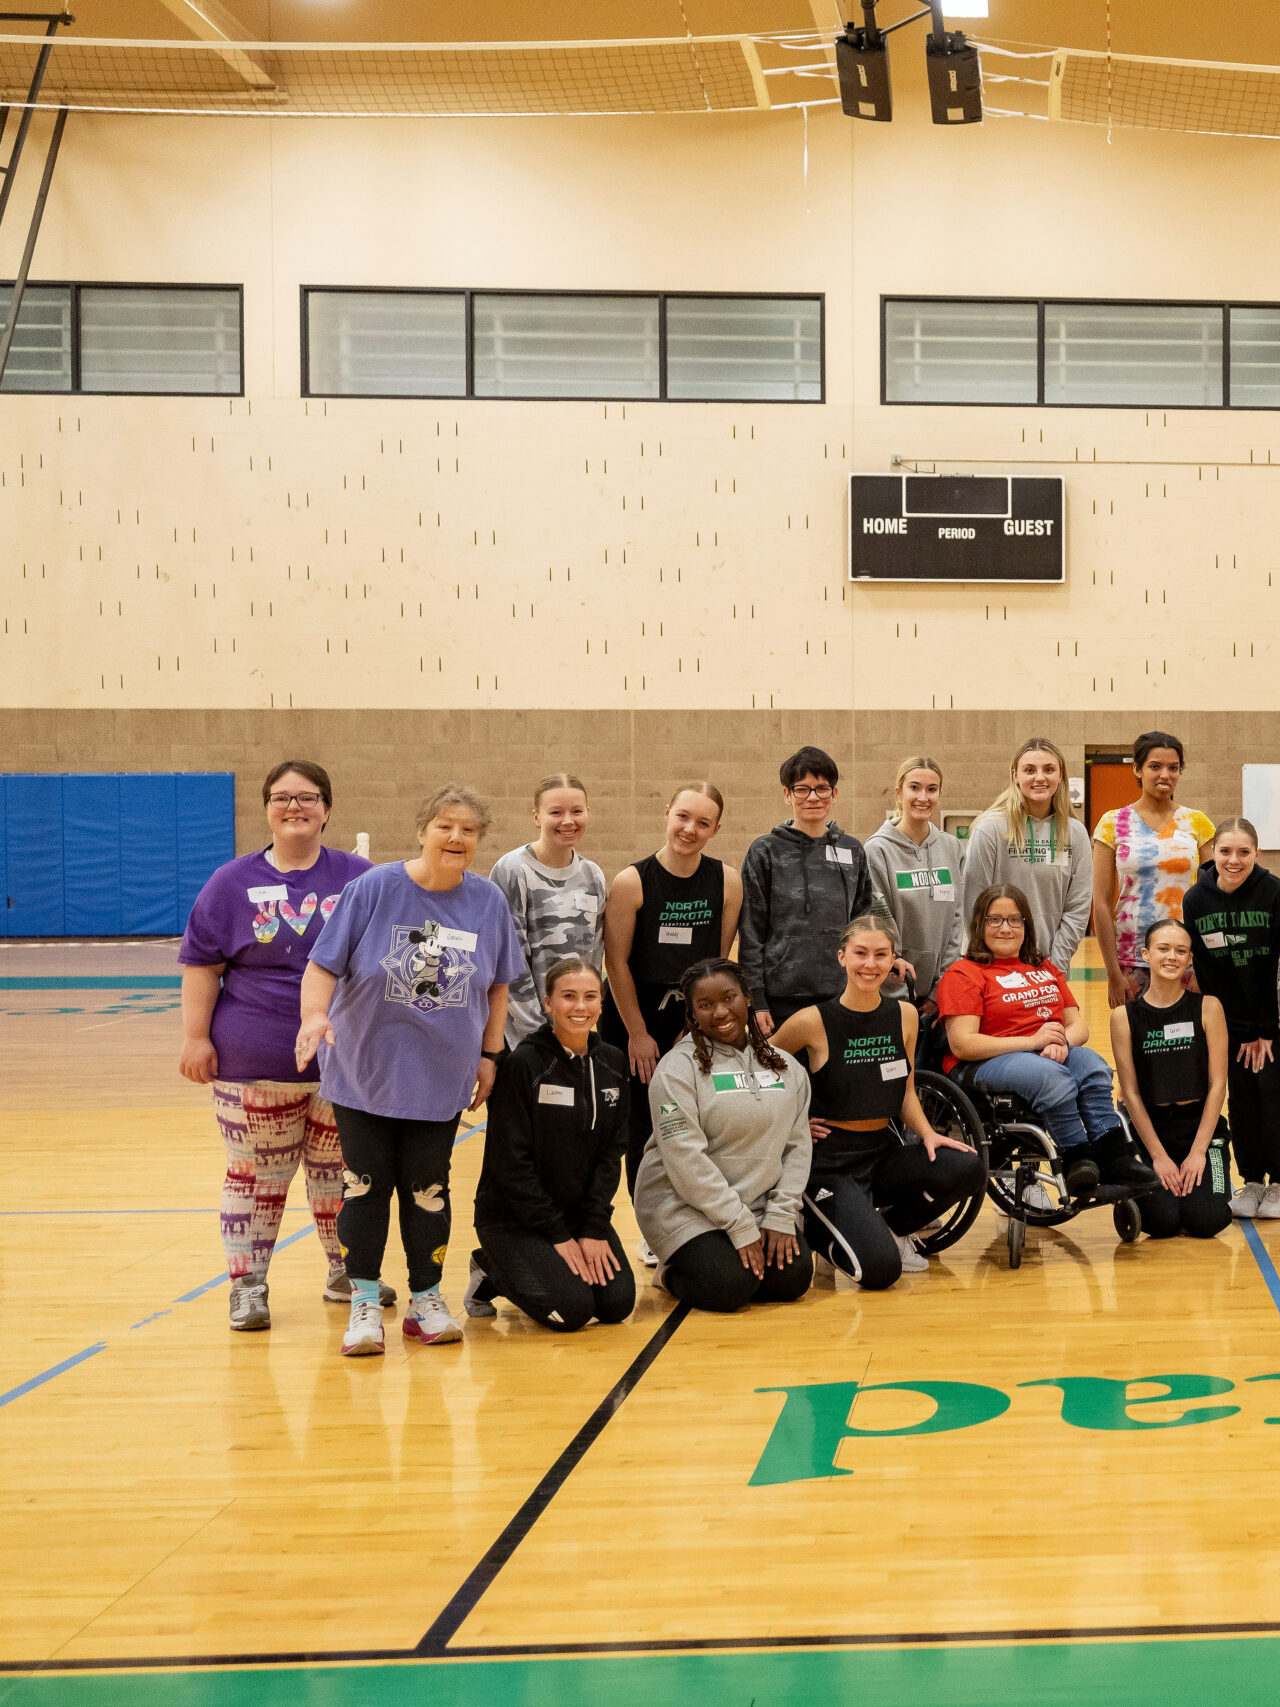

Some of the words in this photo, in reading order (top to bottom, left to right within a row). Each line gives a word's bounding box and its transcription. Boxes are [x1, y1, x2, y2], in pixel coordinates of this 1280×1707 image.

[863, 518, 908, 535] HOME
[938, 527, 976, 540] PERIOD
[1003, 519, 1054, 536] GUEST
[665, 899, 708, 911] NORTH
[659, 909, 713, 921] DAKOTA
[1002, 989, 1039, 1003] GRAND
[1039, 984, 1060, 996] FOR
[847, 1035, 892, 1048] NORTH
[1142, 1037, 1193, 1049] DAKOTA
[843, 1045, 896, 1058] DAKOTA
